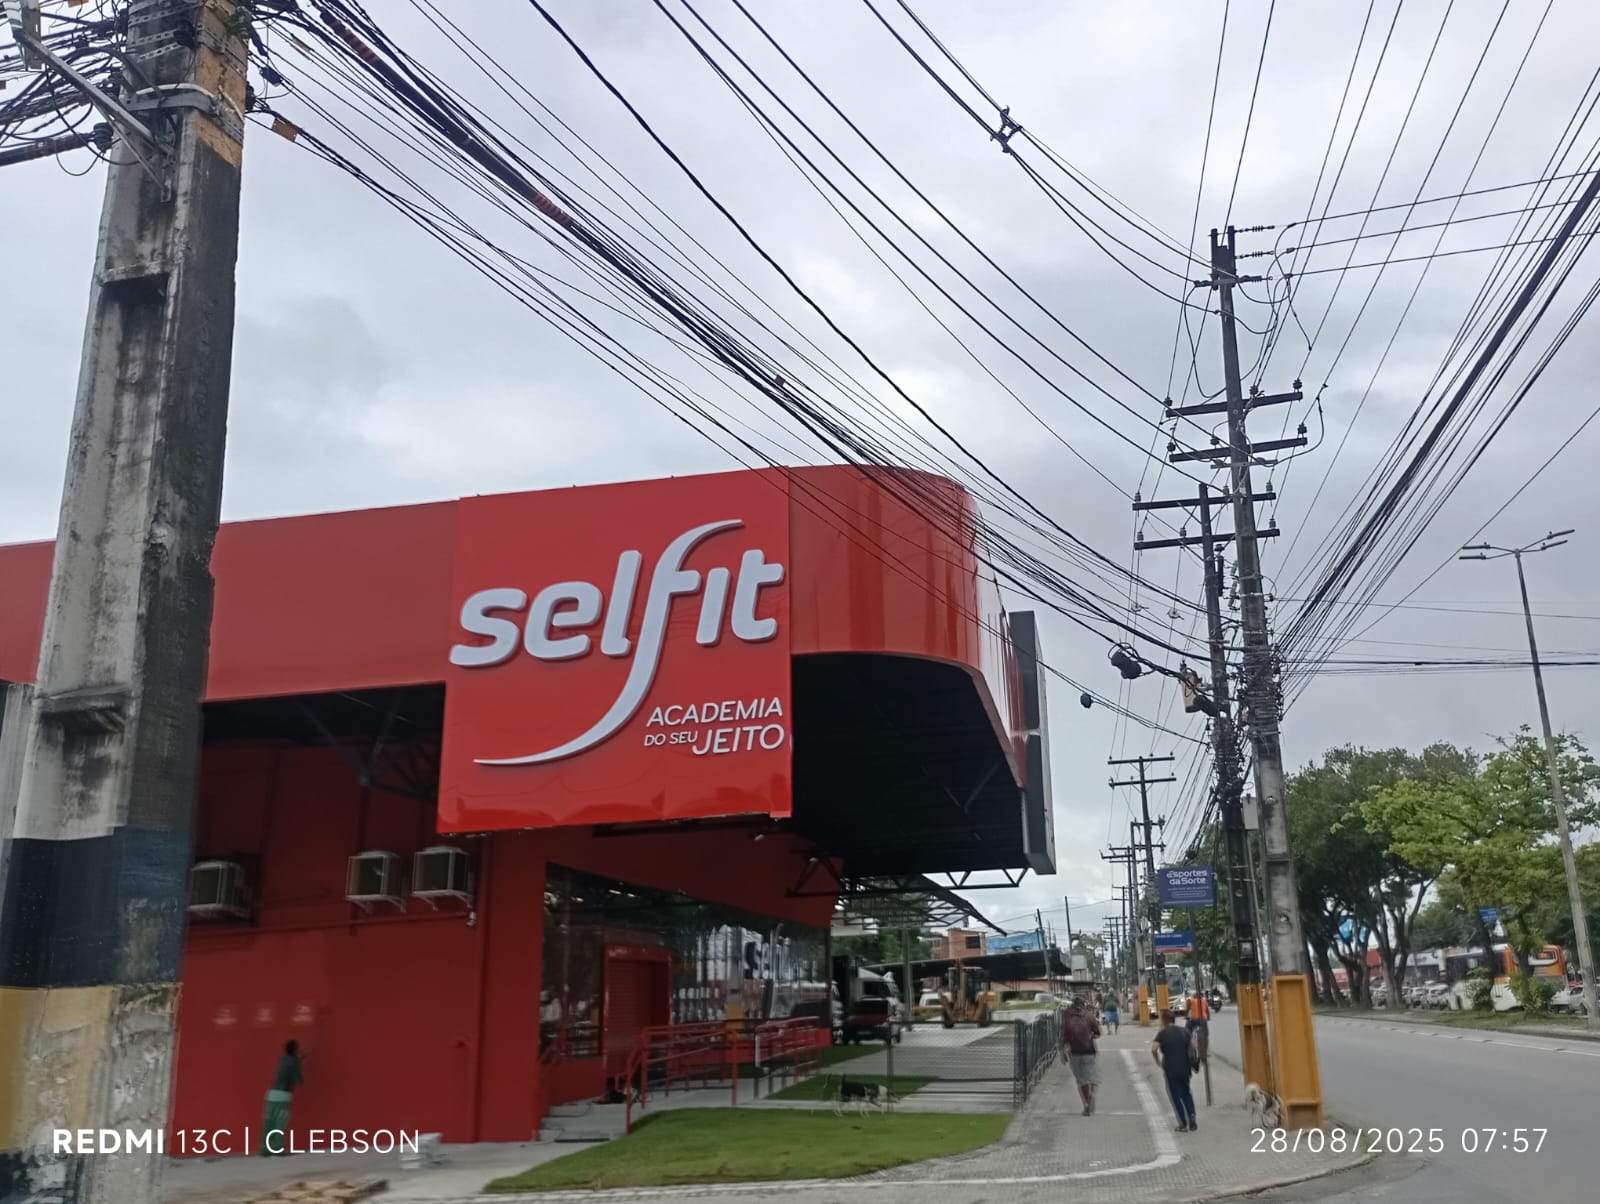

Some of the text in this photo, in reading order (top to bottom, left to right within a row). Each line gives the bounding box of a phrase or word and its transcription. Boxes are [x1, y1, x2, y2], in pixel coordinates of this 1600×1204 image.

[449, 519, 785, 764] selfit
[646, 697, 784, 727] ACADEMIA
[643, 724, 786, 756] DO SEU JEITO
